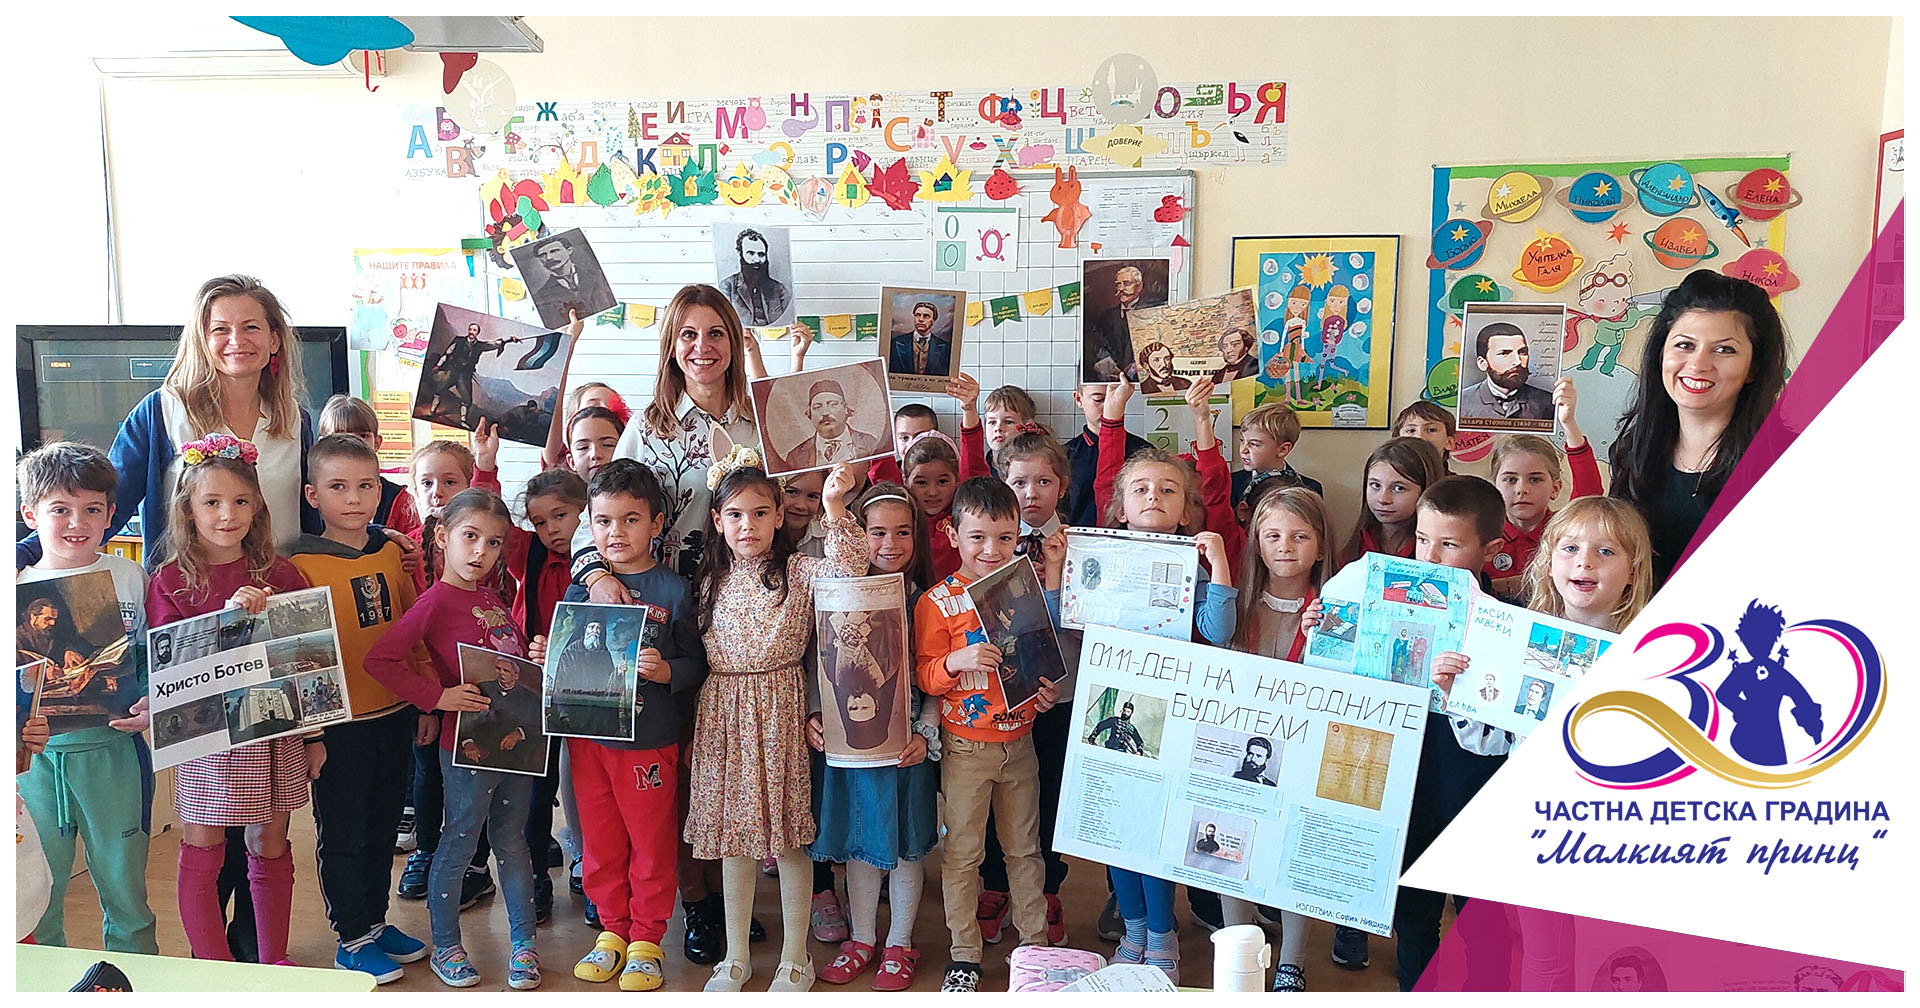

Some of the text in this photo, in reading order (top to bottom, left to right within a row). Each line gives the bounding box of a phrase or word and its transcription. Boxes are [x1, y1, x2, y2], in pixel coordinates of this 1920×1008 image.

[1107, 137, 1143, 149] ДОВЕРИЕ
[1155, 407, 1170, 431] 2
[359, 606, 391, 622] 1987
[155, 657, 264, 699] Христо Ботев
[1203, 665, 1236, 695] НА
[1254, 674, 1425, 731] НАРОДНИТЕ
[991, 709, 1027, 723] SONIC
[1171, 692, 1310, 745] БУДИТЕЛИ
[633, 763, 663, 791] M
